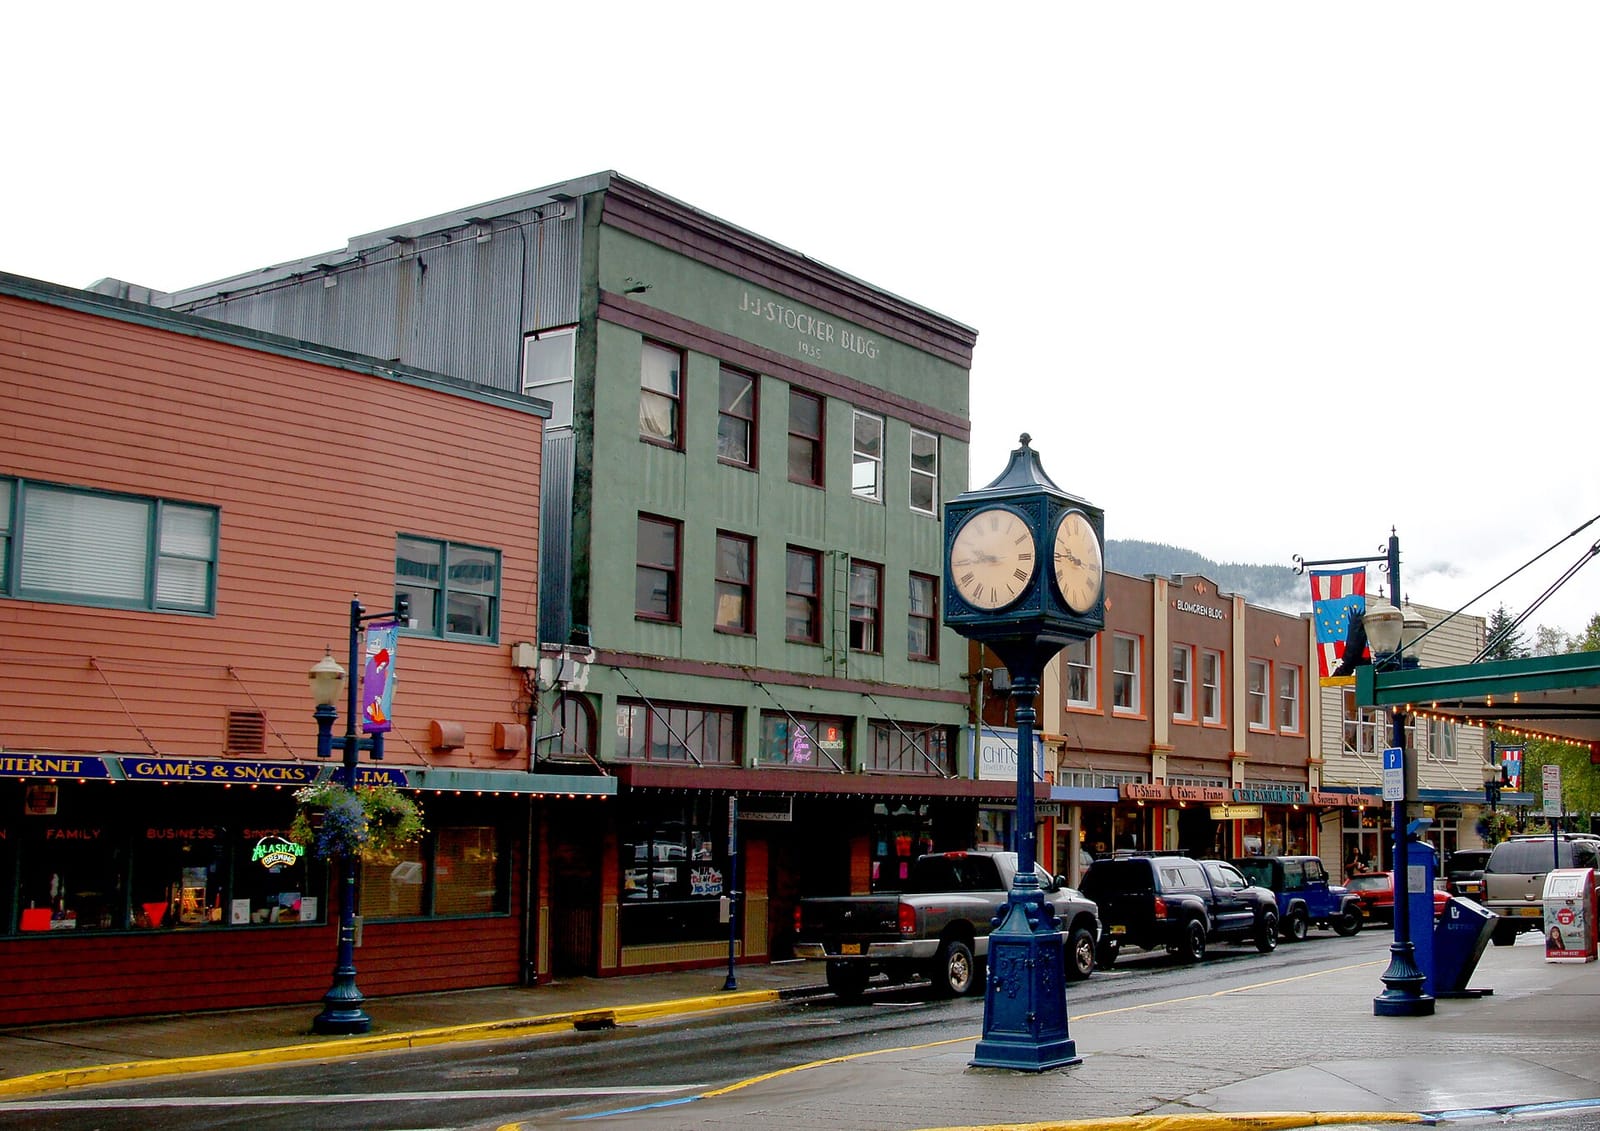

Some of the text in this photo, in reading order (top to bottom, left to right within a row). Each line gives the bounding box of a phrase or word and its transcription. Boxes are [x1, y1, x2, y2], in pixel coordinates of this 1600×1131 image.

[1177, 599, 1208, 616] BLOMGREN
[1390, 753, 1396, 769] P
[136, 762, 306, 780] GAMES & SNACKS
[1134, 784, 1162, 798] T-Shirts
[1177, 786, 1197, 799] Fabric
[1203, 788, 1224, 800] Frames
[1252, 790, 1283, 802] FRANKLIN
[46, 828, 101, 840] FAMILY
[146, 828, 216, 840] BUSINESS
[251, 843, 304, 862] ALASKAN
